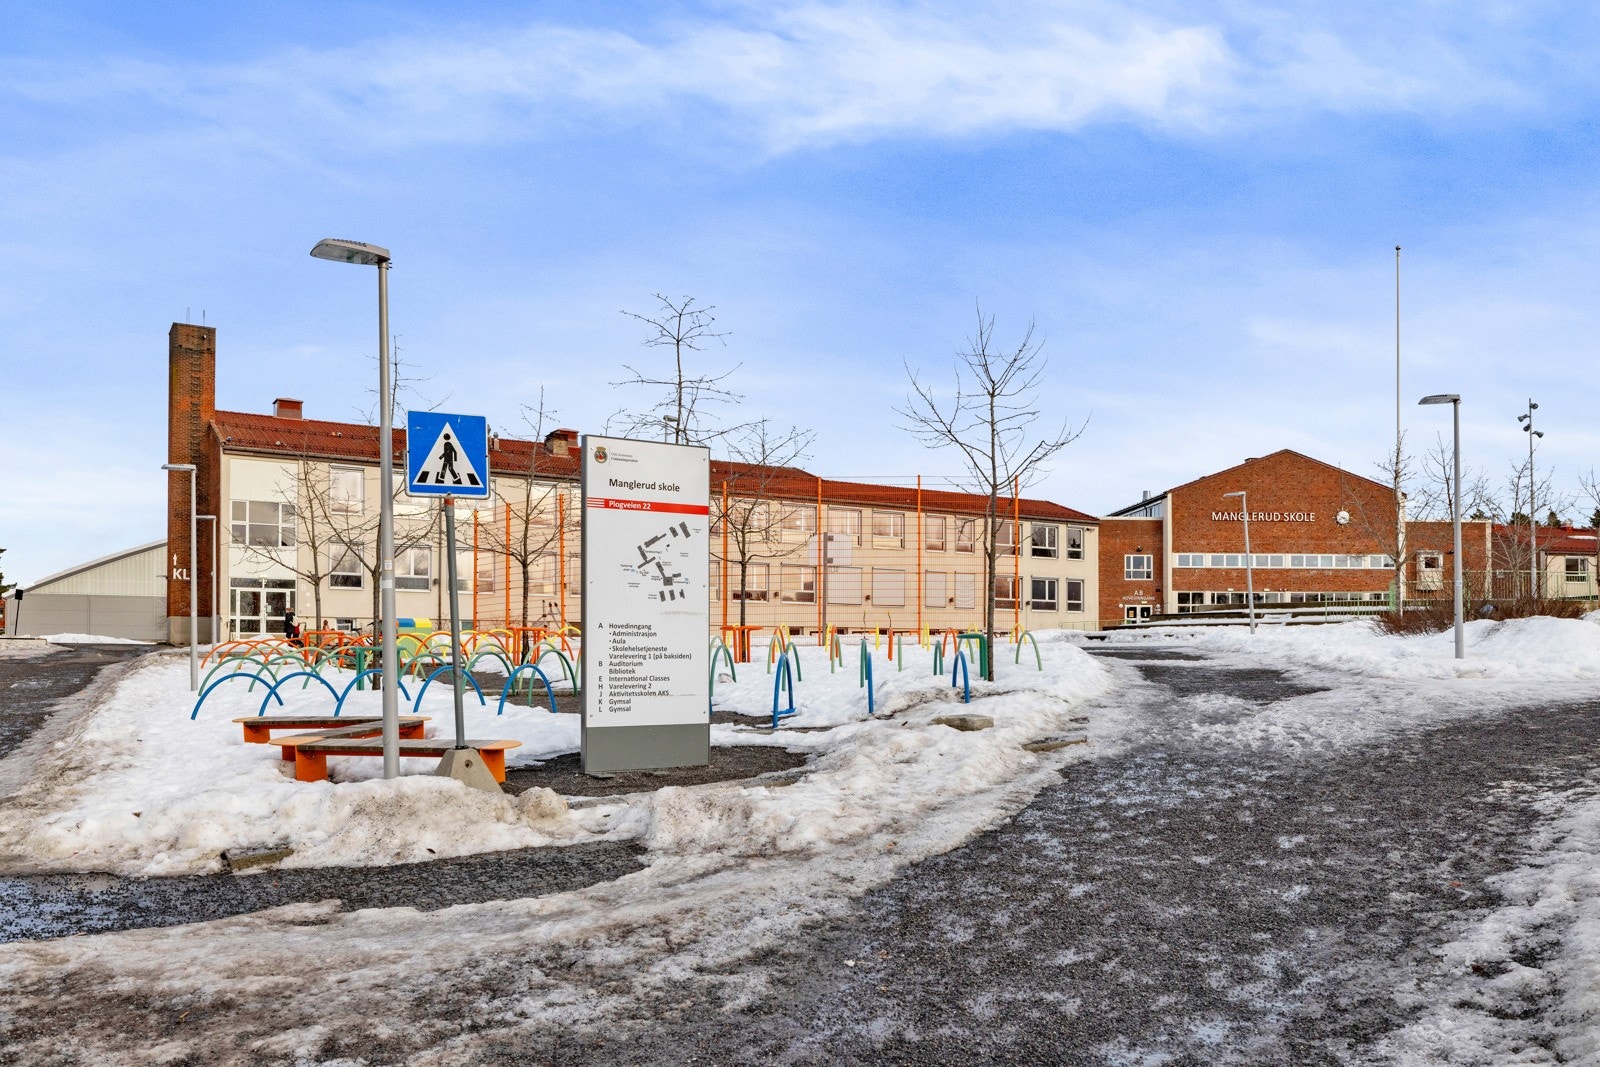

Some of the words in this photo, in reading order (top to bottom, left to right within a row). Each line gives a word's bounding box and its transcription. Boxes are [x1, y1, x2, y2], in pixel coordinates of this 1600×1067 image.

[609, 478, 656, 491] Manglerud
[658, 482, 680, 492] skole
[609, 500, 641, 510] Plogveien
[642, 502, 651, 510] 22
[1211, 511, 1280, 522] MANGLERUD
[1283, 512, 1315, 522] SKOLE
[172, 568, 191, 580] KL
